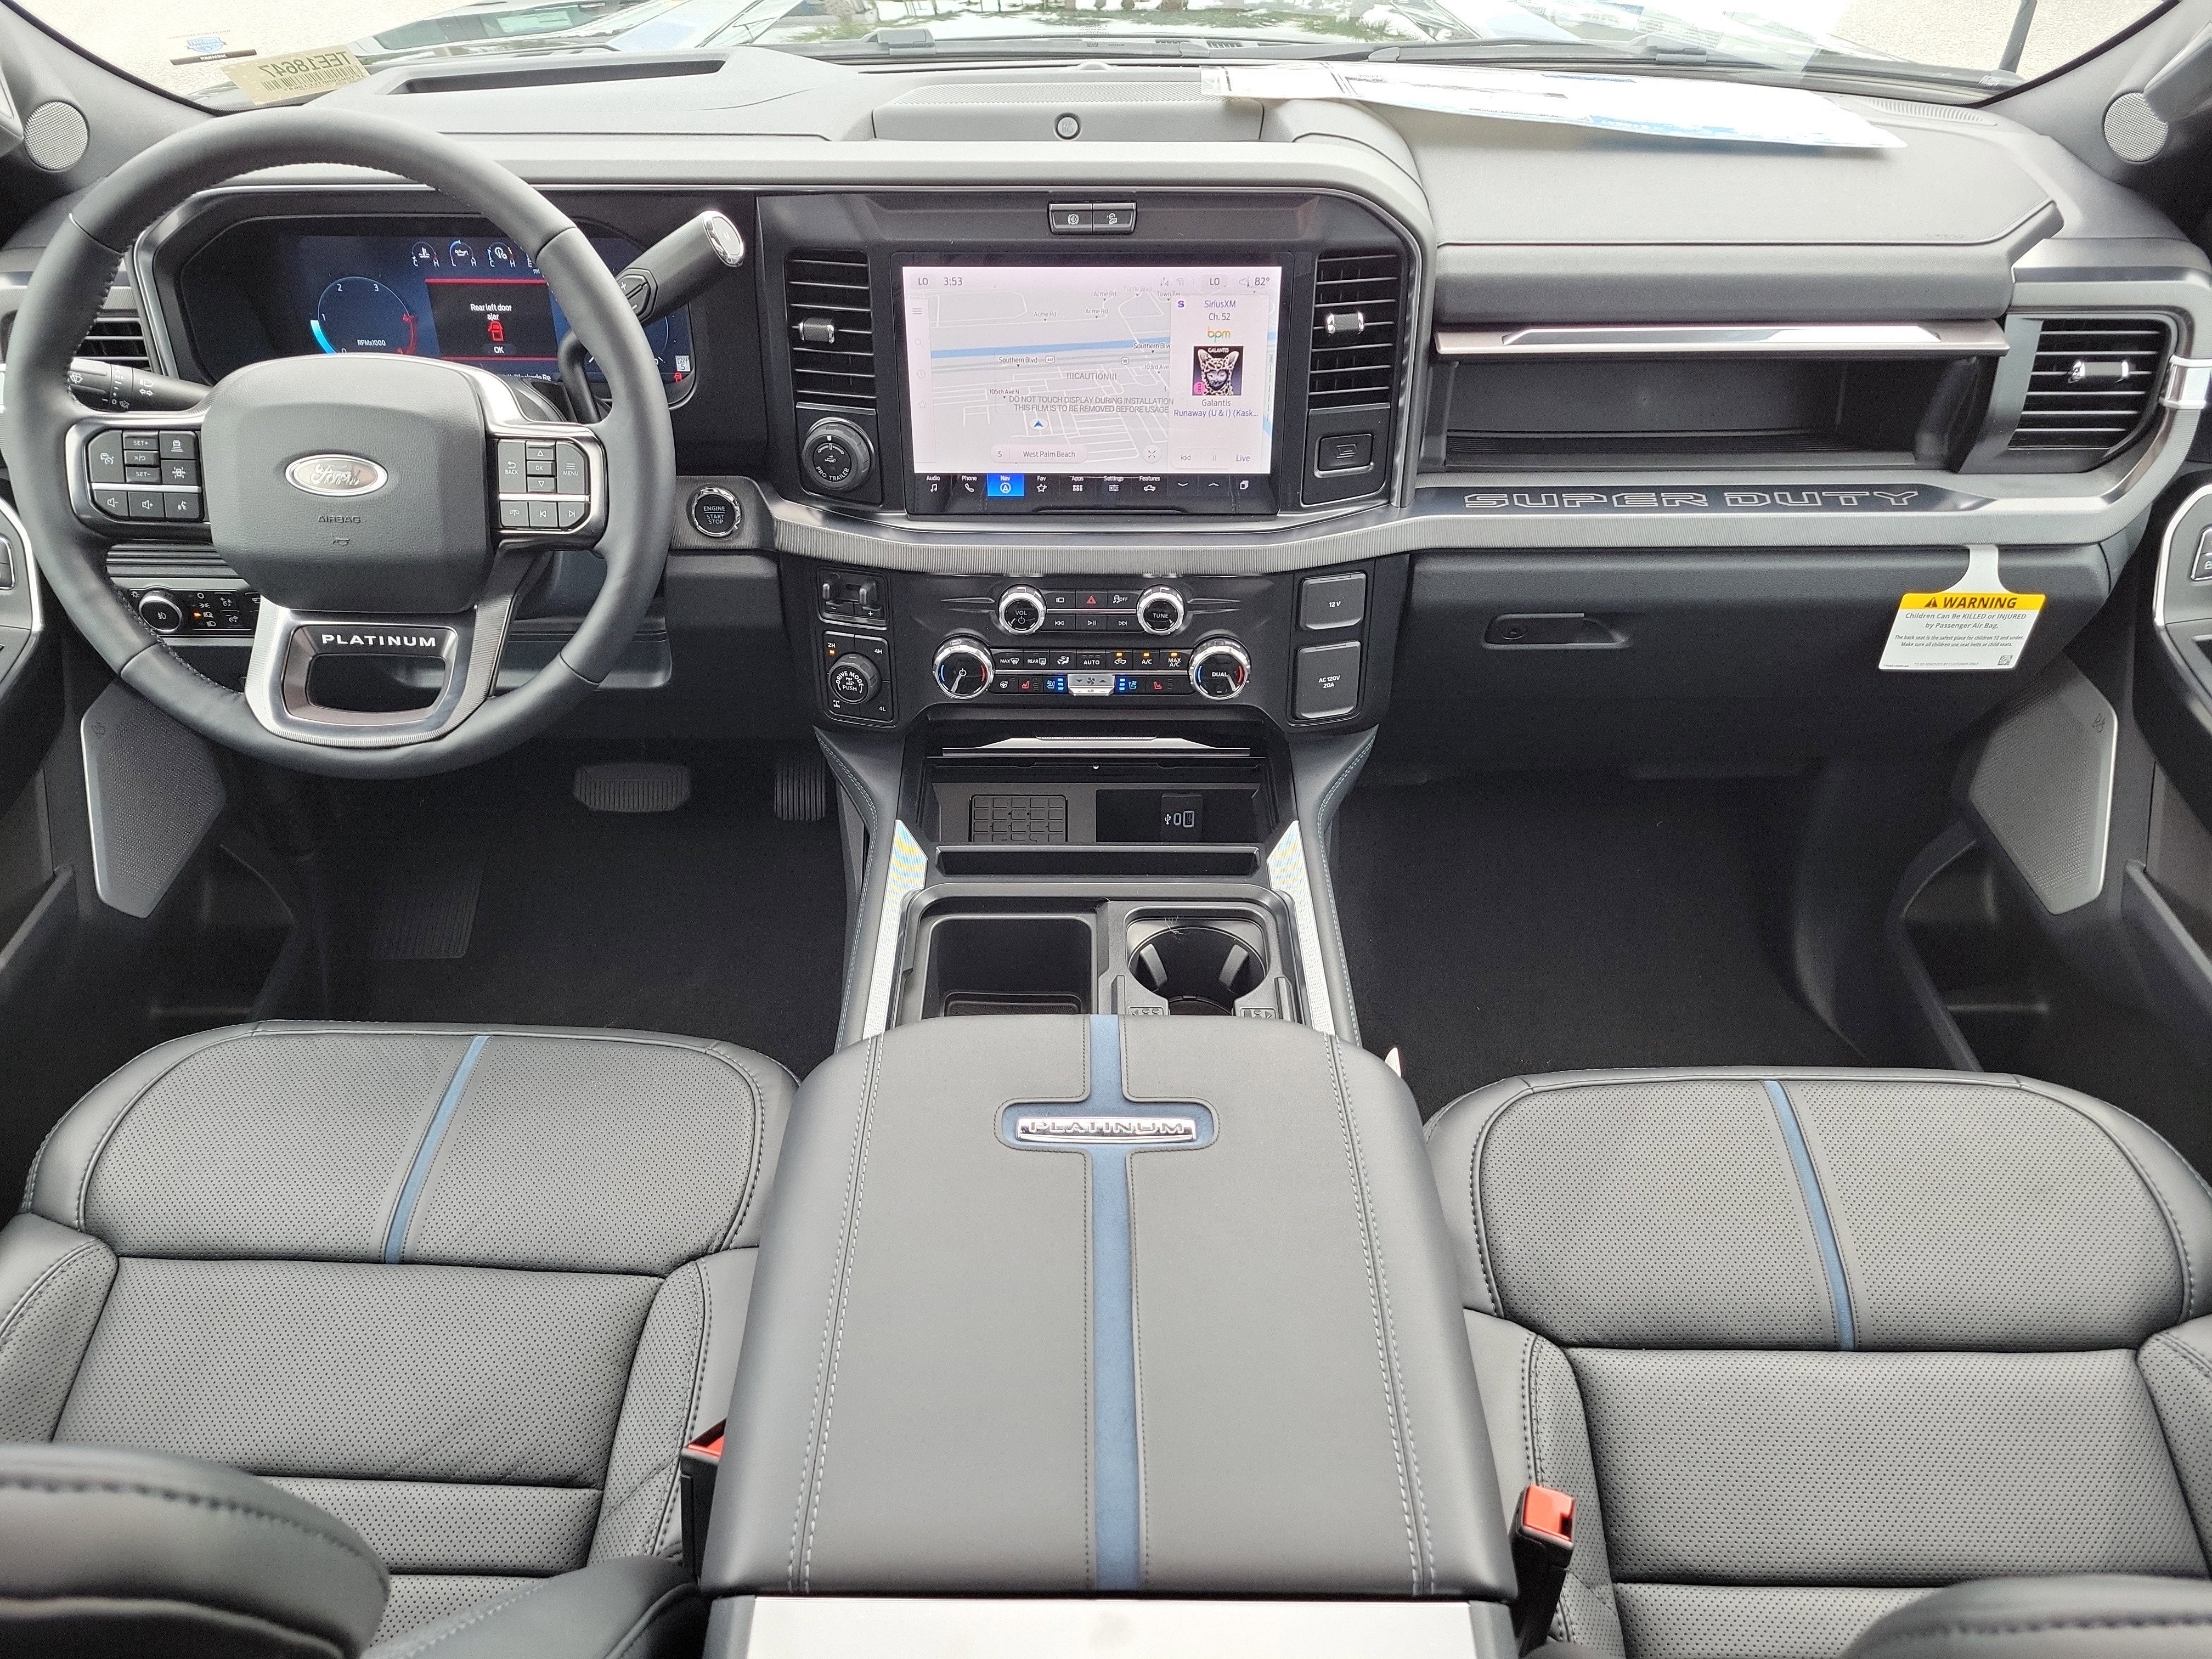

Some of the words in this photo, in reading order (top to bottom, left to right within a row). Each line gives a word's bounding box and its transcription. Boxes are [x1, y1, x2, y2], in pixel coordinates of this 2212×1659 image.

[944, 277, 963, 286] 3:53
[1254, 277, 1270, 286] 82°
[374, 284, 379, 292] 3
[470, 303, 485, 312] Rear
[486, 303, 496, 312] left
[498, 303, 512, 312] door
[1204, 300, 1236, 308] SiriusXM
[488, 313, 499, 321] ajar
[1207, 326, 1231, 343] bpm
[1173, 409, 1206, 418] Runaway
[816, 466, 827, 478] PRO
[829, 467, 850, 481] TRAILER
[1464, 492, 1709, 509] SUPER
[1724, 490, 1920, 506] DUTY
[318, 515, 361, 523] AIRBAG
[1942, 596, 2017, 609] WARNING
[321, 634, 436, 647] PLATINUM
[836, 671, 849, 685] DRIVE
[849, 671, 864, 687] MODE
[1030, 1121, 1184, 1134] PLATINUM
